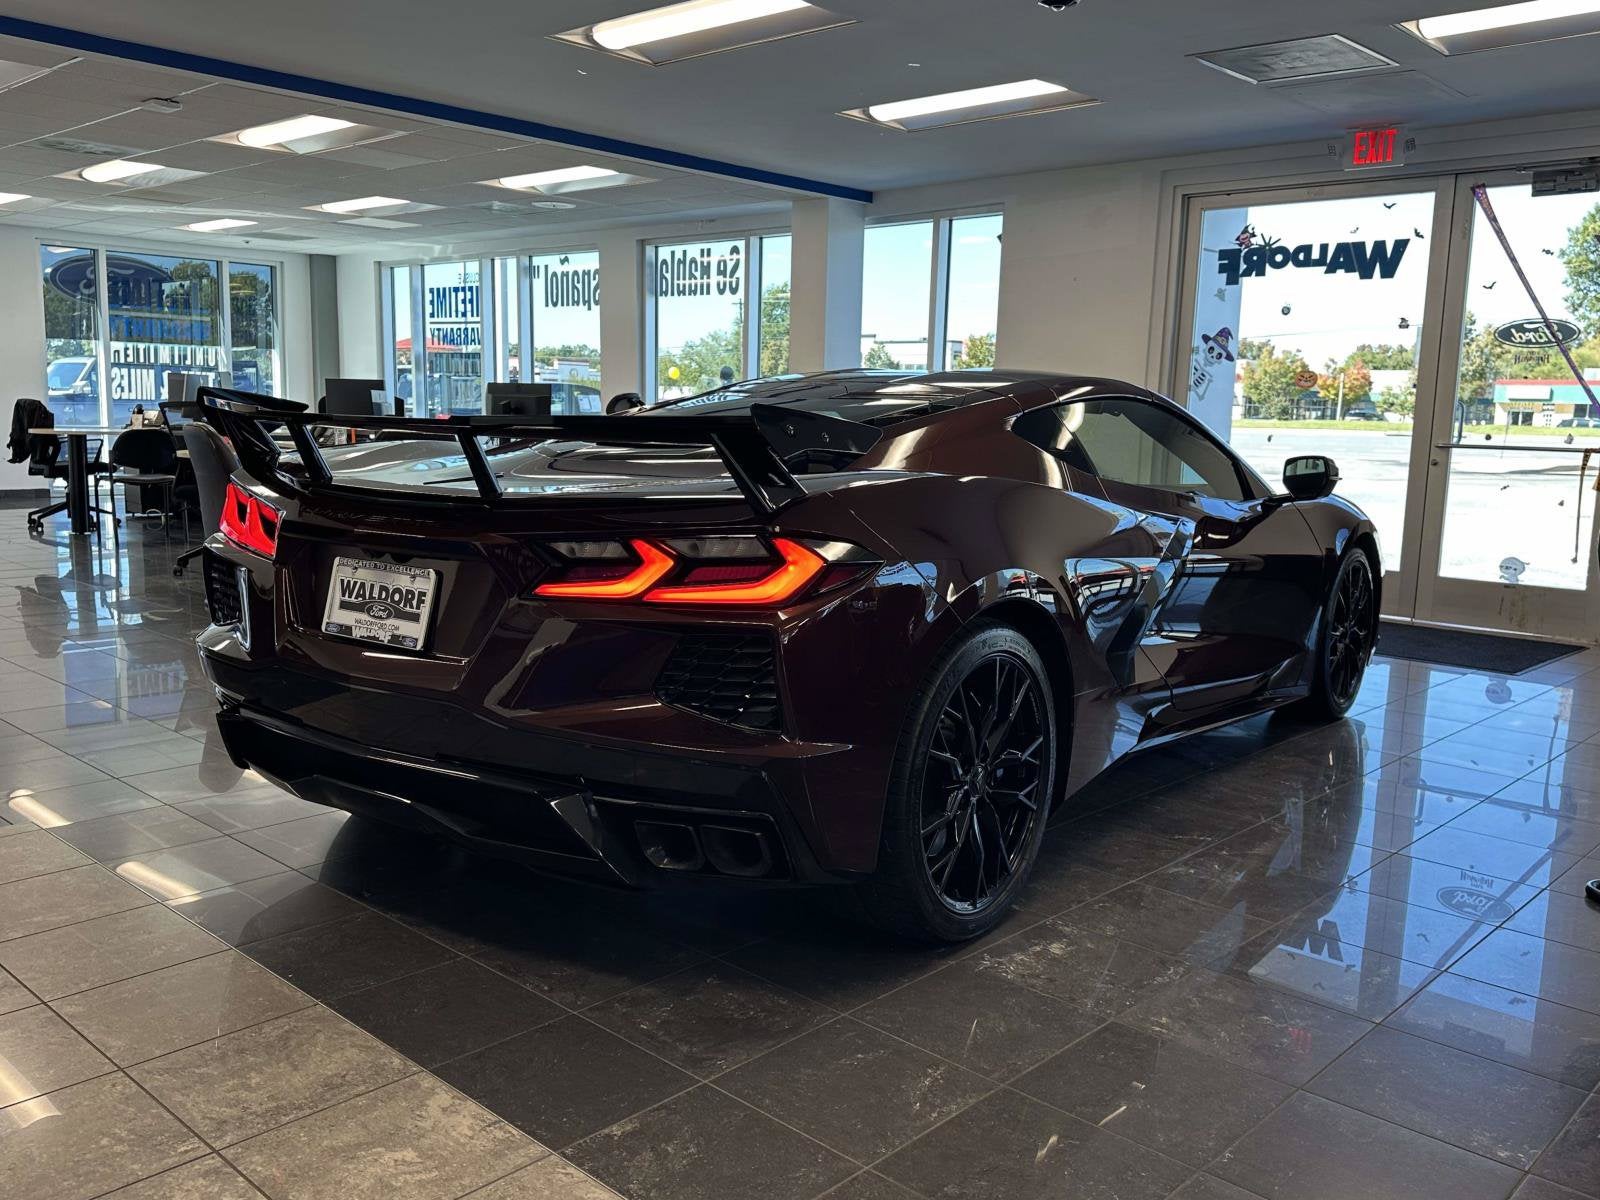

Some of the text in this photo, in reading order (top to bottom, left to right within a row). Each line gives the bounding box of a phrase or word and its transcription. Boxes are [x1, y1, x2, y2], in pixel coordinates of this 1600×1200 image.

[1353, 128, 1398, 165] EXIT
[339, 558, 430, 577] DEDICATED TO EXCELLENCE
[340, 577, 428, 612] WALDORF
[369, 605, 389, 618] Ford
[352, 625, 393, 644] WALDORF
